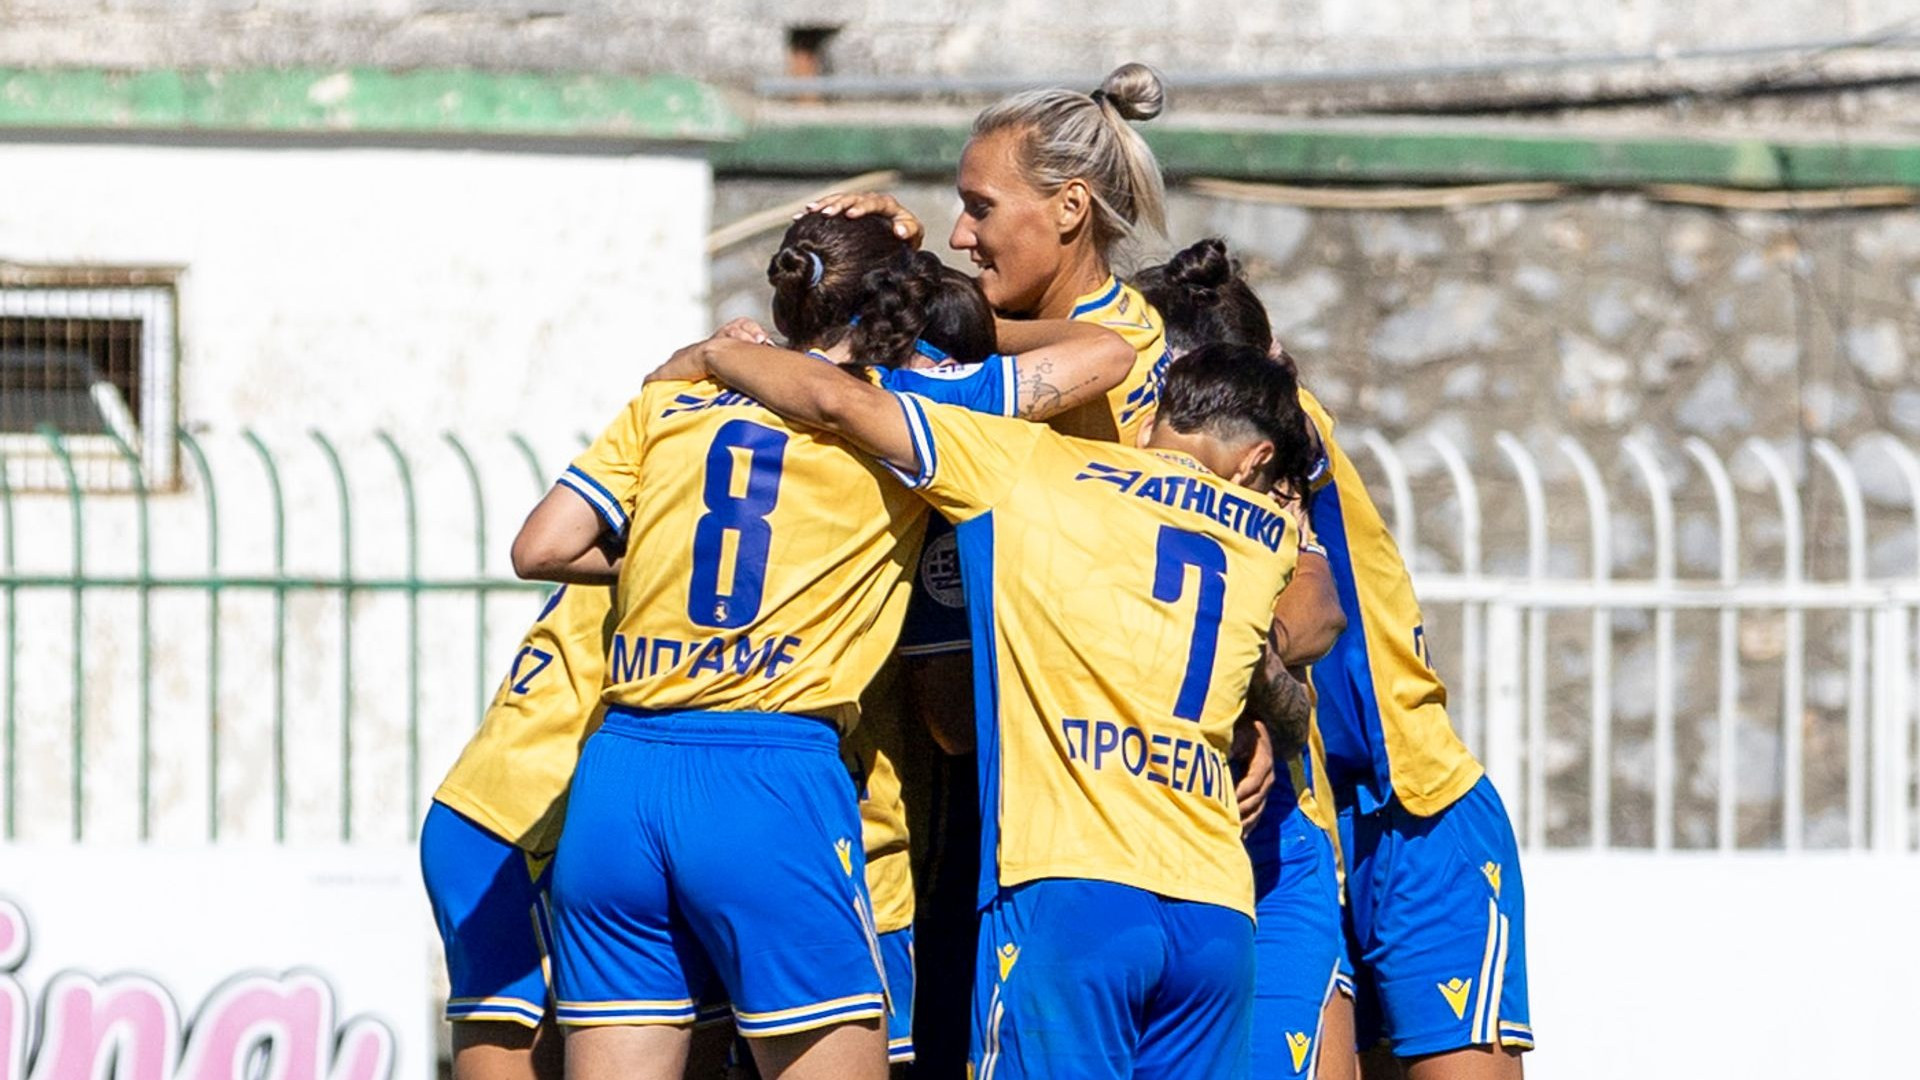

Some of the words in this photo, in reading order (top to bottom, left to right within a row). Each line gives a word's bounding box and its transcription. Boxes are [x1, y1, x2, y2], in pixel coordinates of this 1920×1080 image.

[687, 419, 789, 629] 8
[1135, 476, 1286, 553] ATHLETIKO
[1152, 524, 1227, 722] 7
